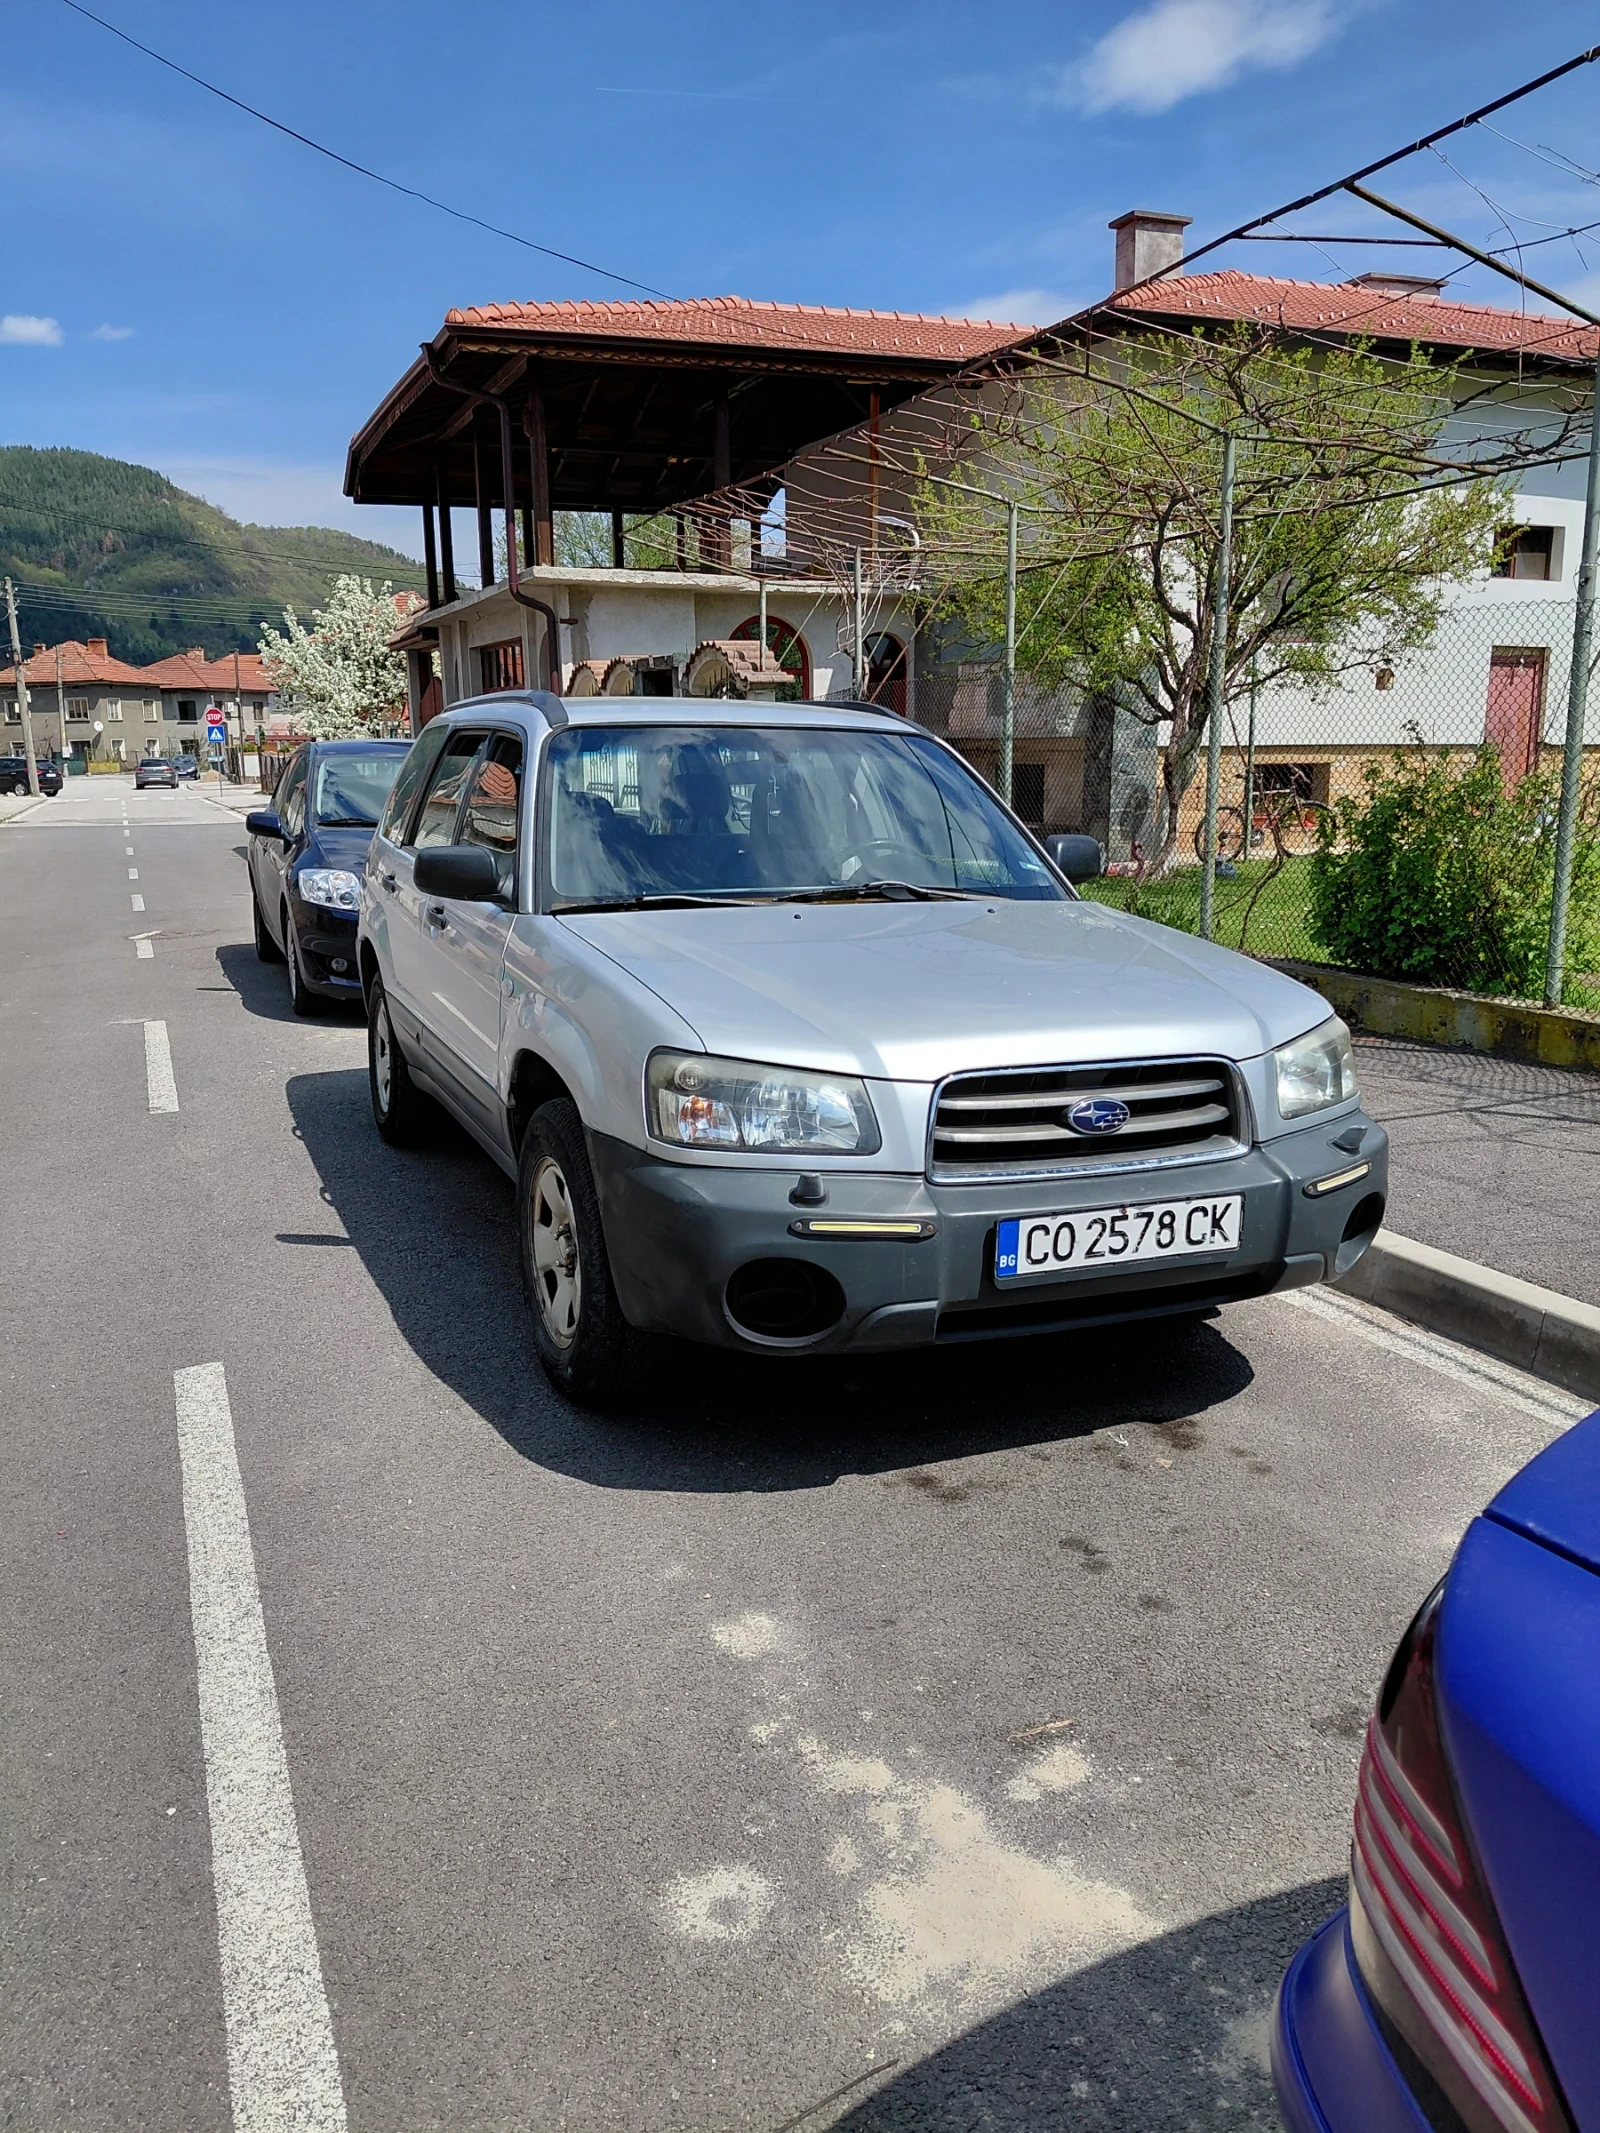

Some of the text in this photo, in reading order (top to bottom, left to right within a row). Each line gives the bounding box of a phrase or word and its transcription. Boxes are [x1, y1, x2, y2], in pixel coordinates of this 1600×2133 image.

[207, 713, 221, 721] STOP
[1025, 1202, 1233, 1265] CO 2578 CK
[999, 1253, 1016, 1268] BG
